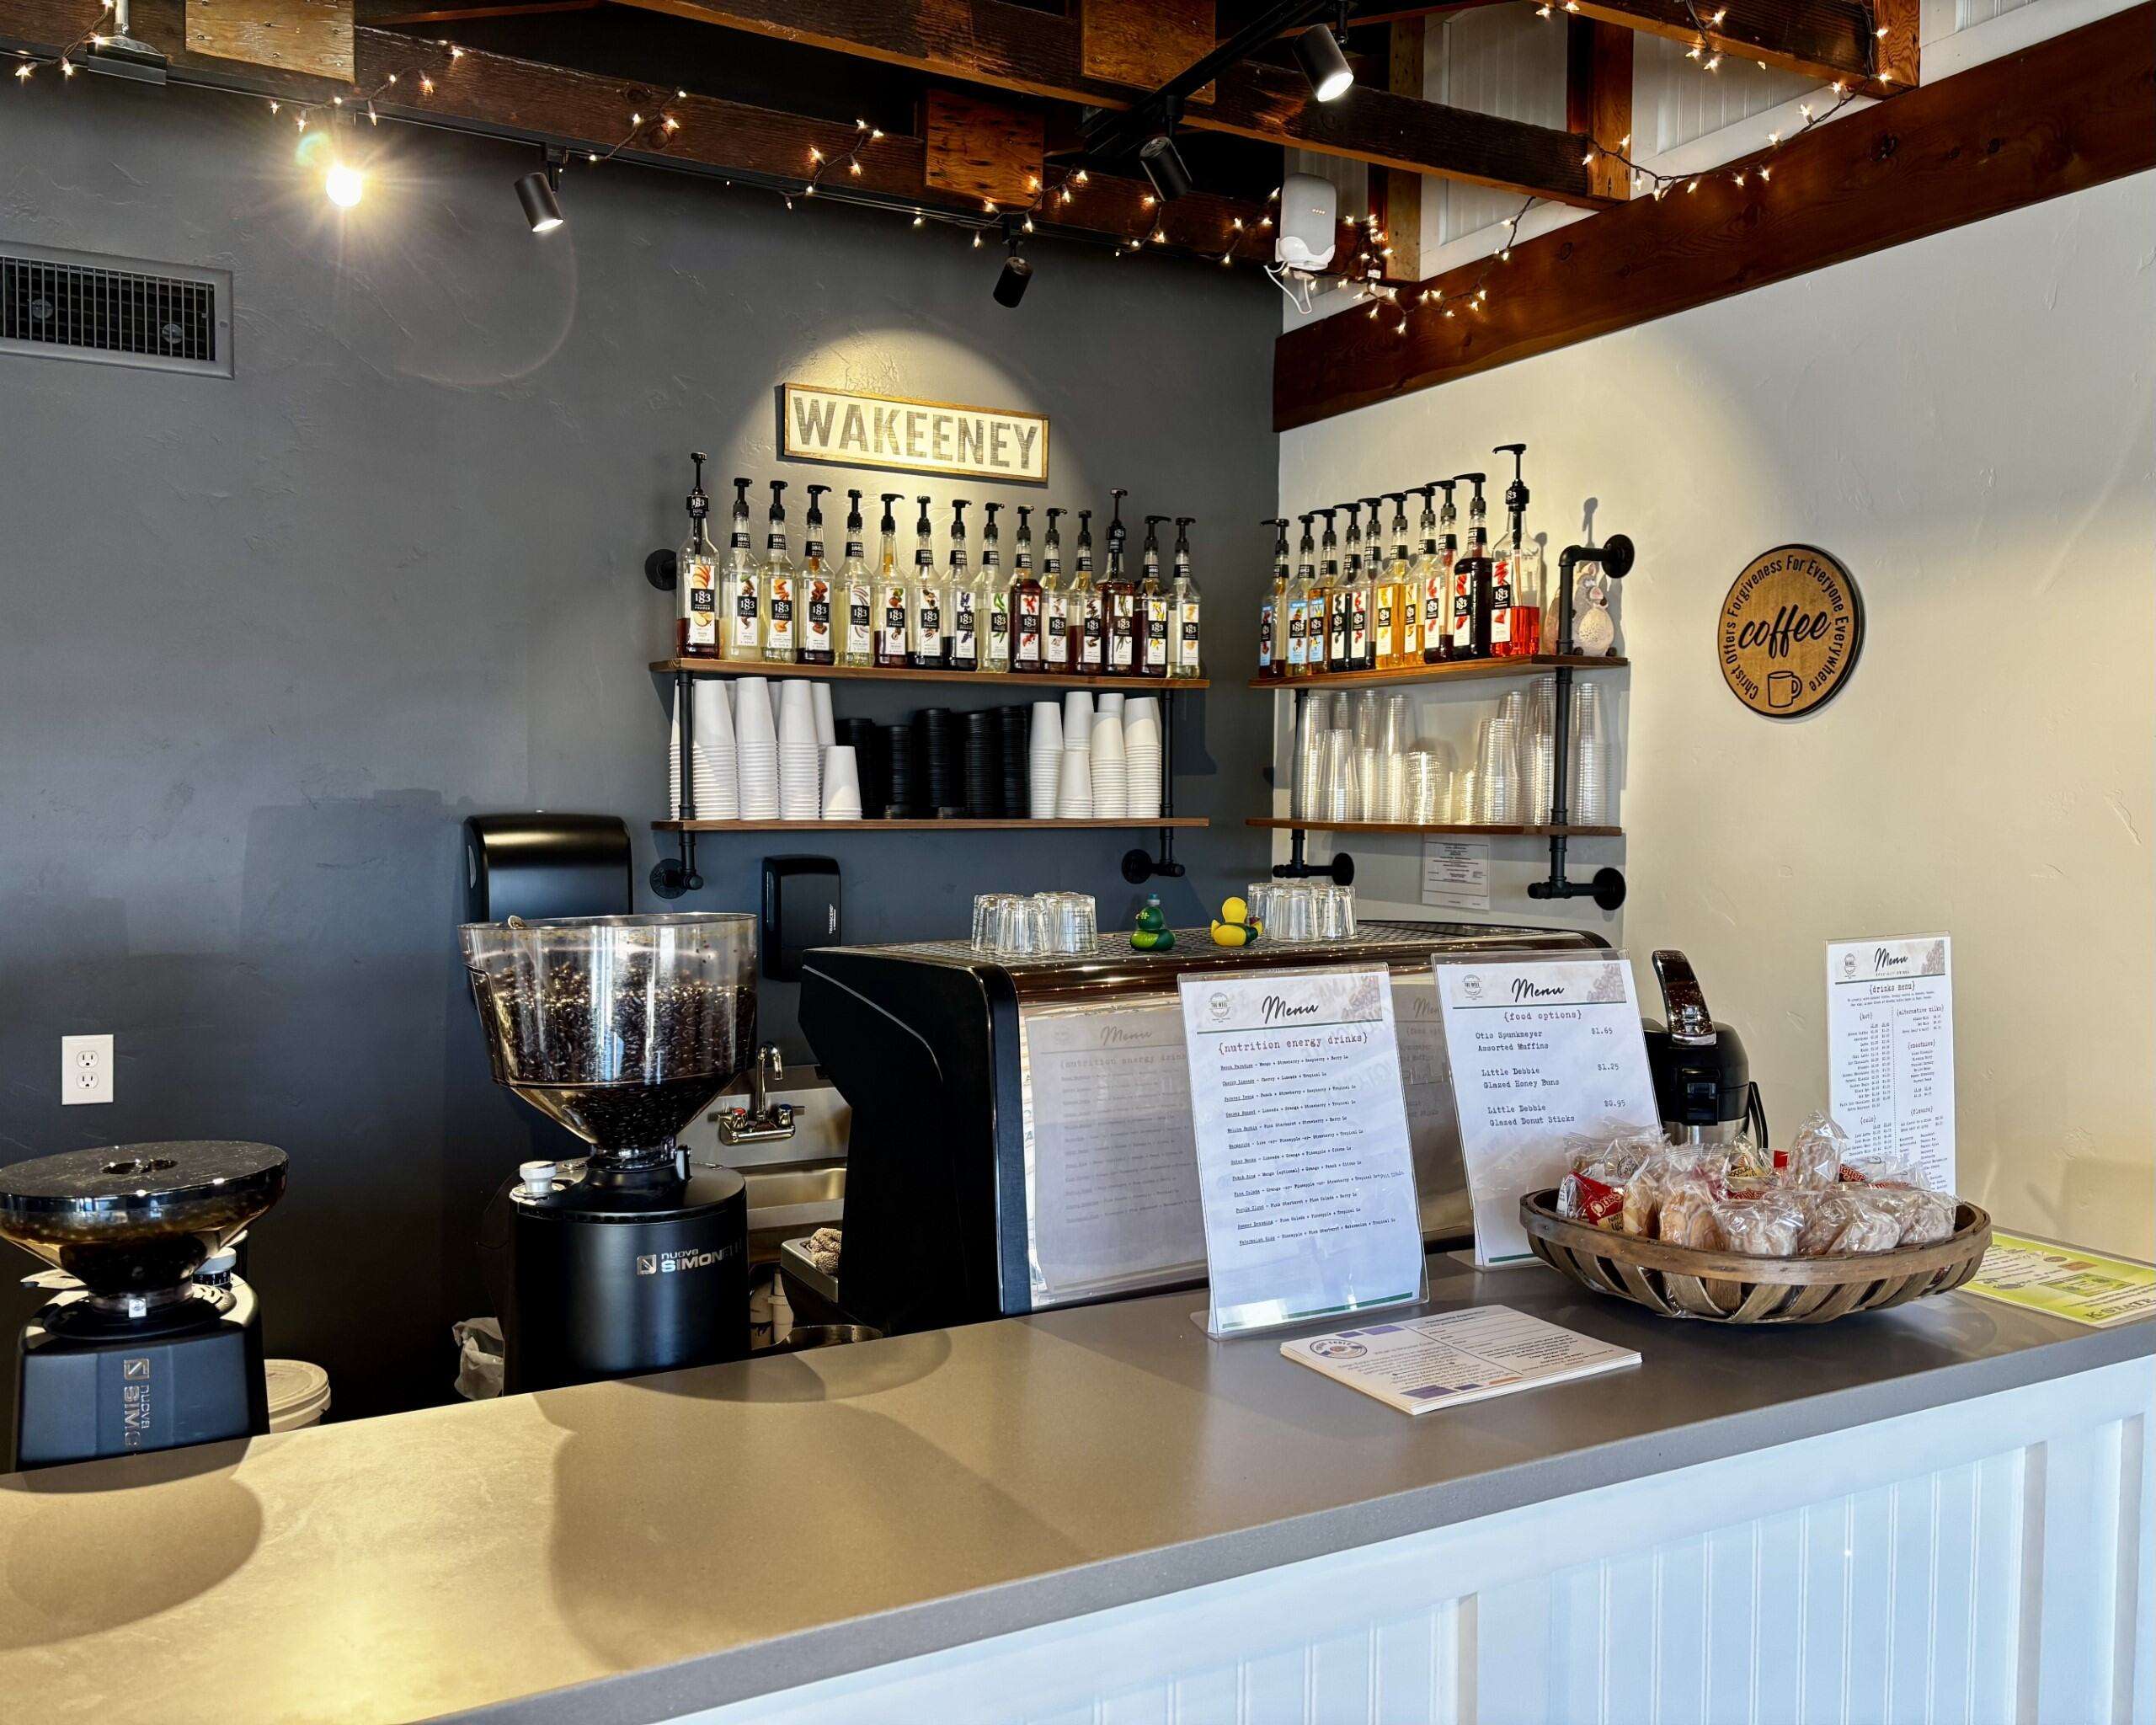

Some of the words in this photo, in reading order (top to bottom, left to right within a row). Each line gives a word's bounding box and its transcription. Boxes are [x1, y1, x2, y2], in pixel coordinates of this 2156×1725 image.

[793, 397, 1039, 469] WAKEENEY
[1786, 555, 1805, 570] For
[1728, 558, 1782, 618] Forgiveness
[1807, 559, 1844, 612] Everyone
[1724, 622, 1738, 665] Offers
[1738, 604, 1832, 659] coffee
[1809, 616, 1849, 692] Everywhere
[1731, 664, 1758, 700] Christ
[1875, 948, 1908, 972] Menu
[1512, 978, 1565, 1002] Menu
[1262, 996, 1319, 1024] Menu
[1504, 1012, 1532, 1023] {food
[1539, 1010, 1582, 1020] options}
[1219, 1041, 1280, 1055] {nutrition
[1287, 1038, 1321, 1048] energy
[1328, 1032, 1368, 1044] drinks}
[1498, 1031, 1542, 1040] Spunkmeyer
[1490, 1119, 1517, 1127] Glazed
[661, 1248, 699, 1259] nuova
[141, 1385, 150, 1429] nuova
